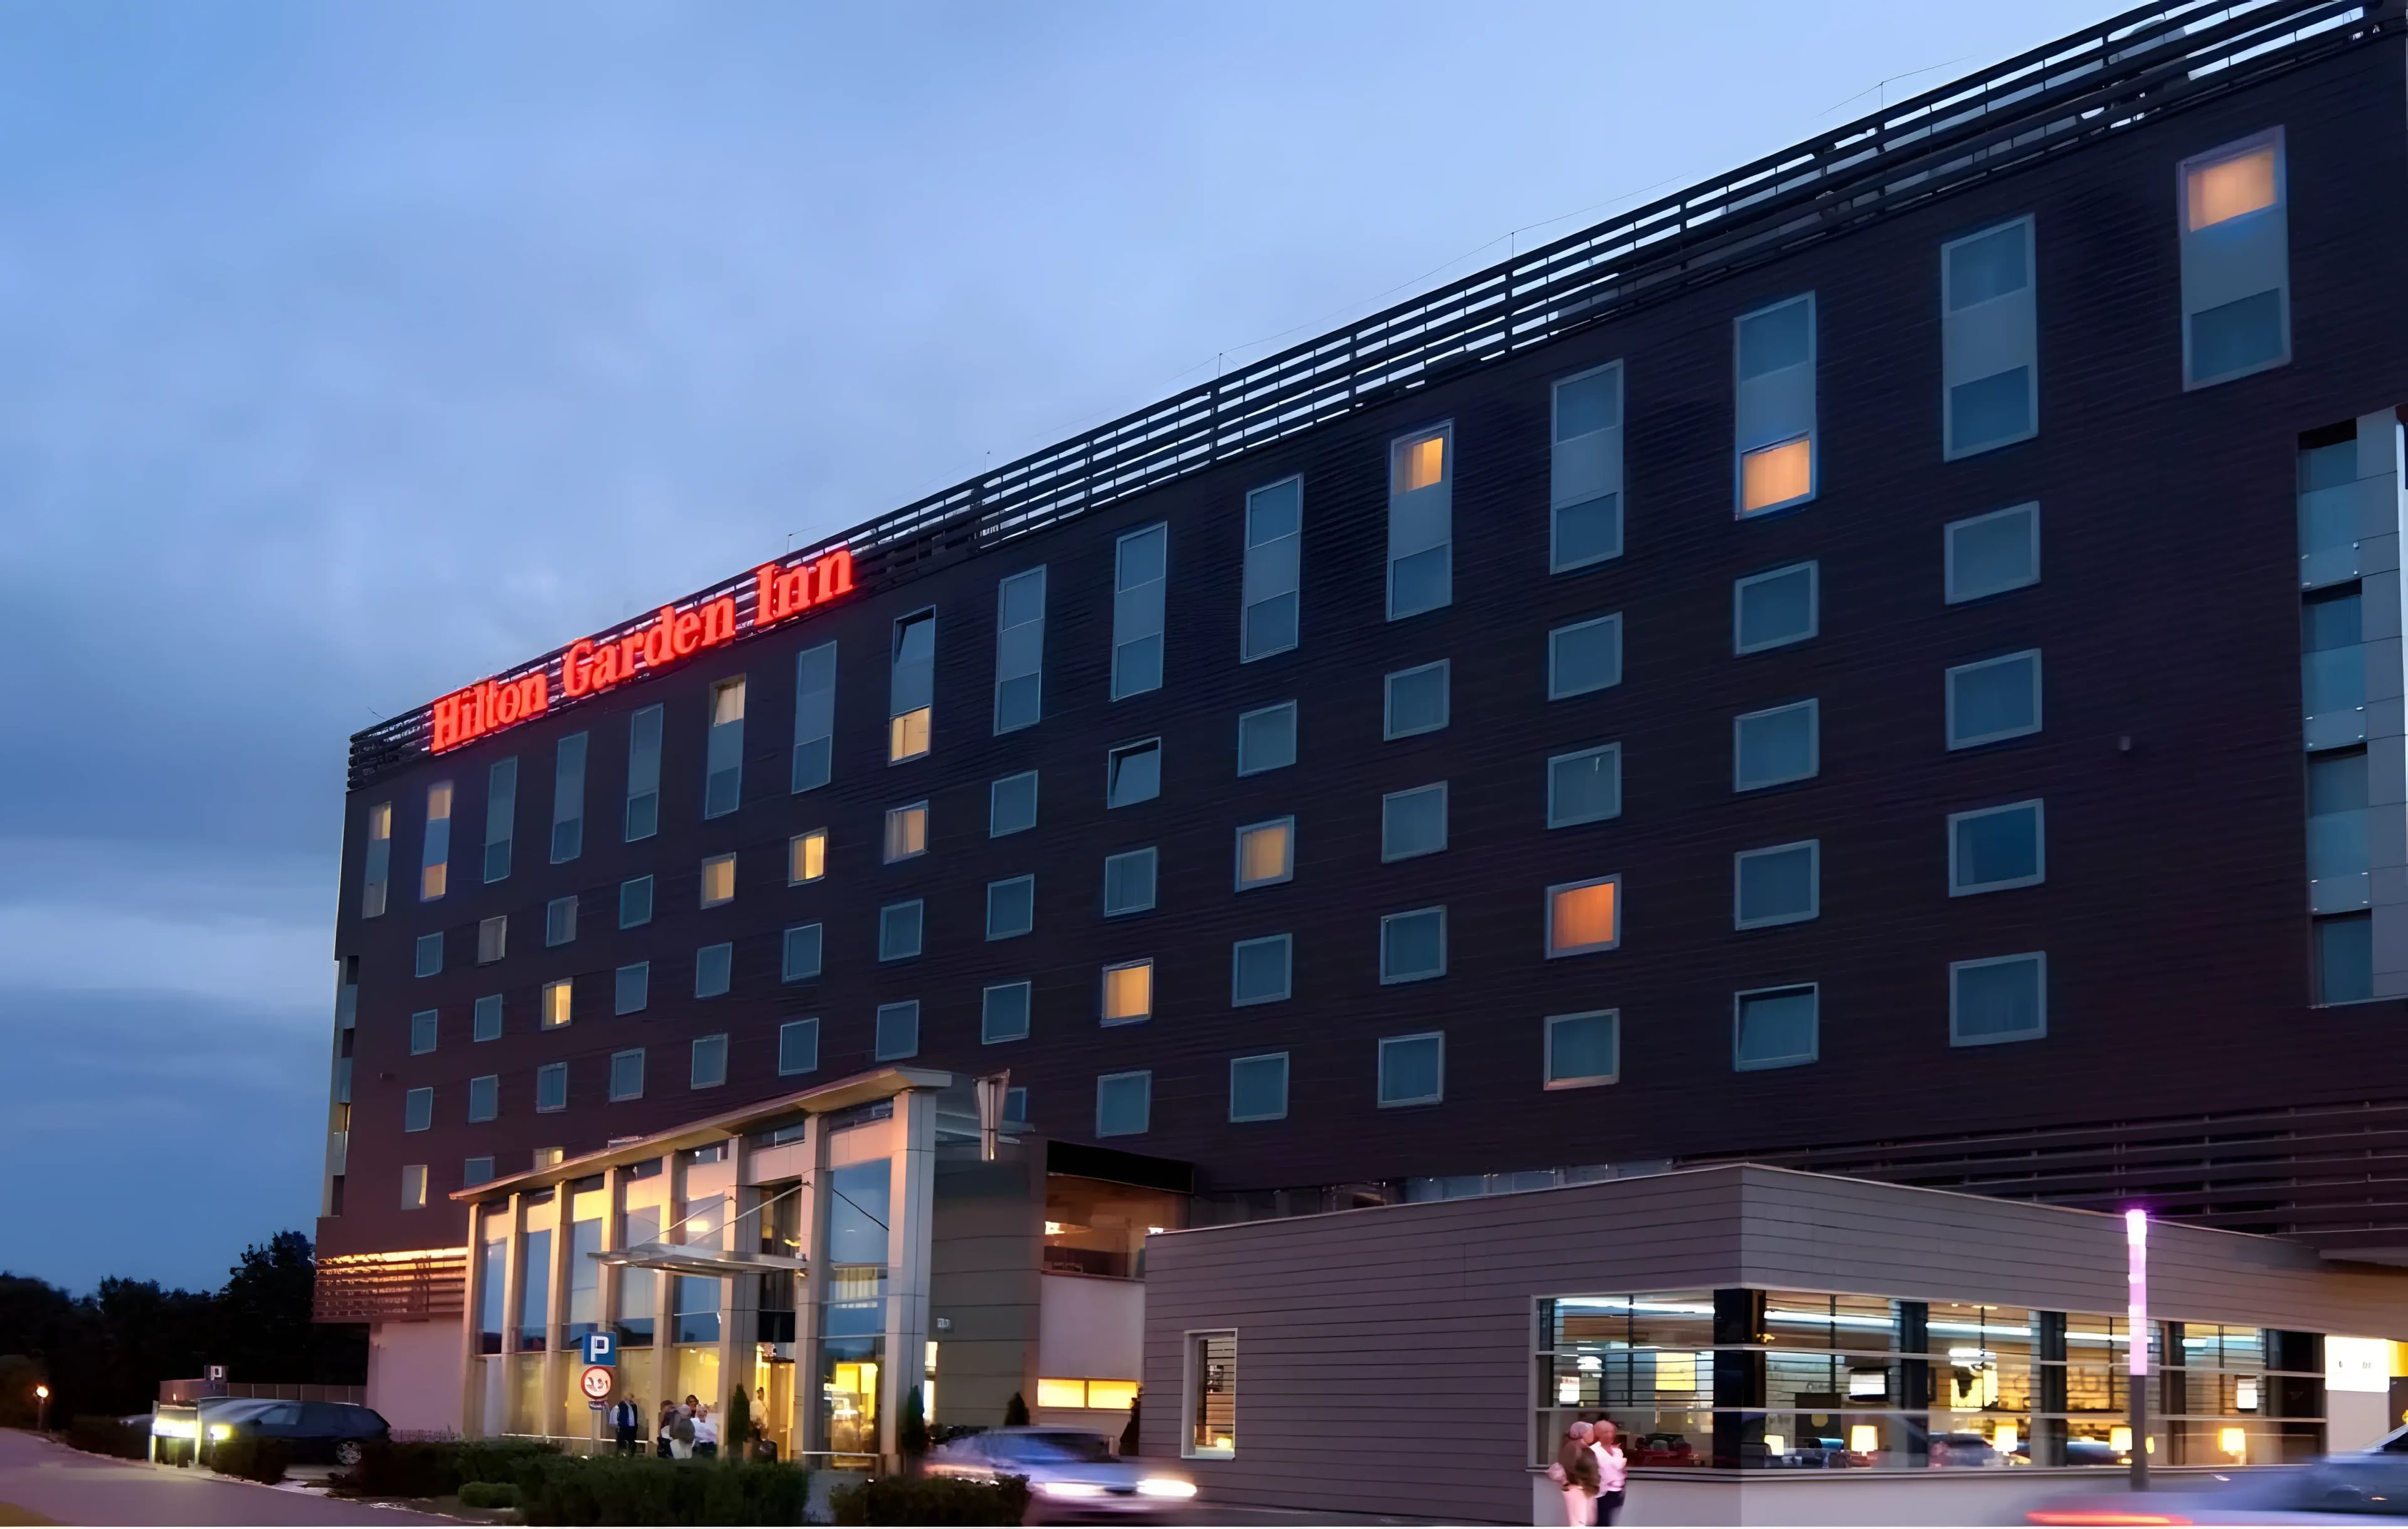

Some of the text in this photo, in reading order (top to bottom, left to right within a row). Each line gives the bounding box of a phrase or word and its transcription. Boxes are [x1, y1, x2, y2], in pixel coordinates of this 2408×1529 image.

[431, 550, 853, 752] Hilton Garden Inn
[591, 1336, 609, 1362] P
[211, 1366, 222, 1380] P
